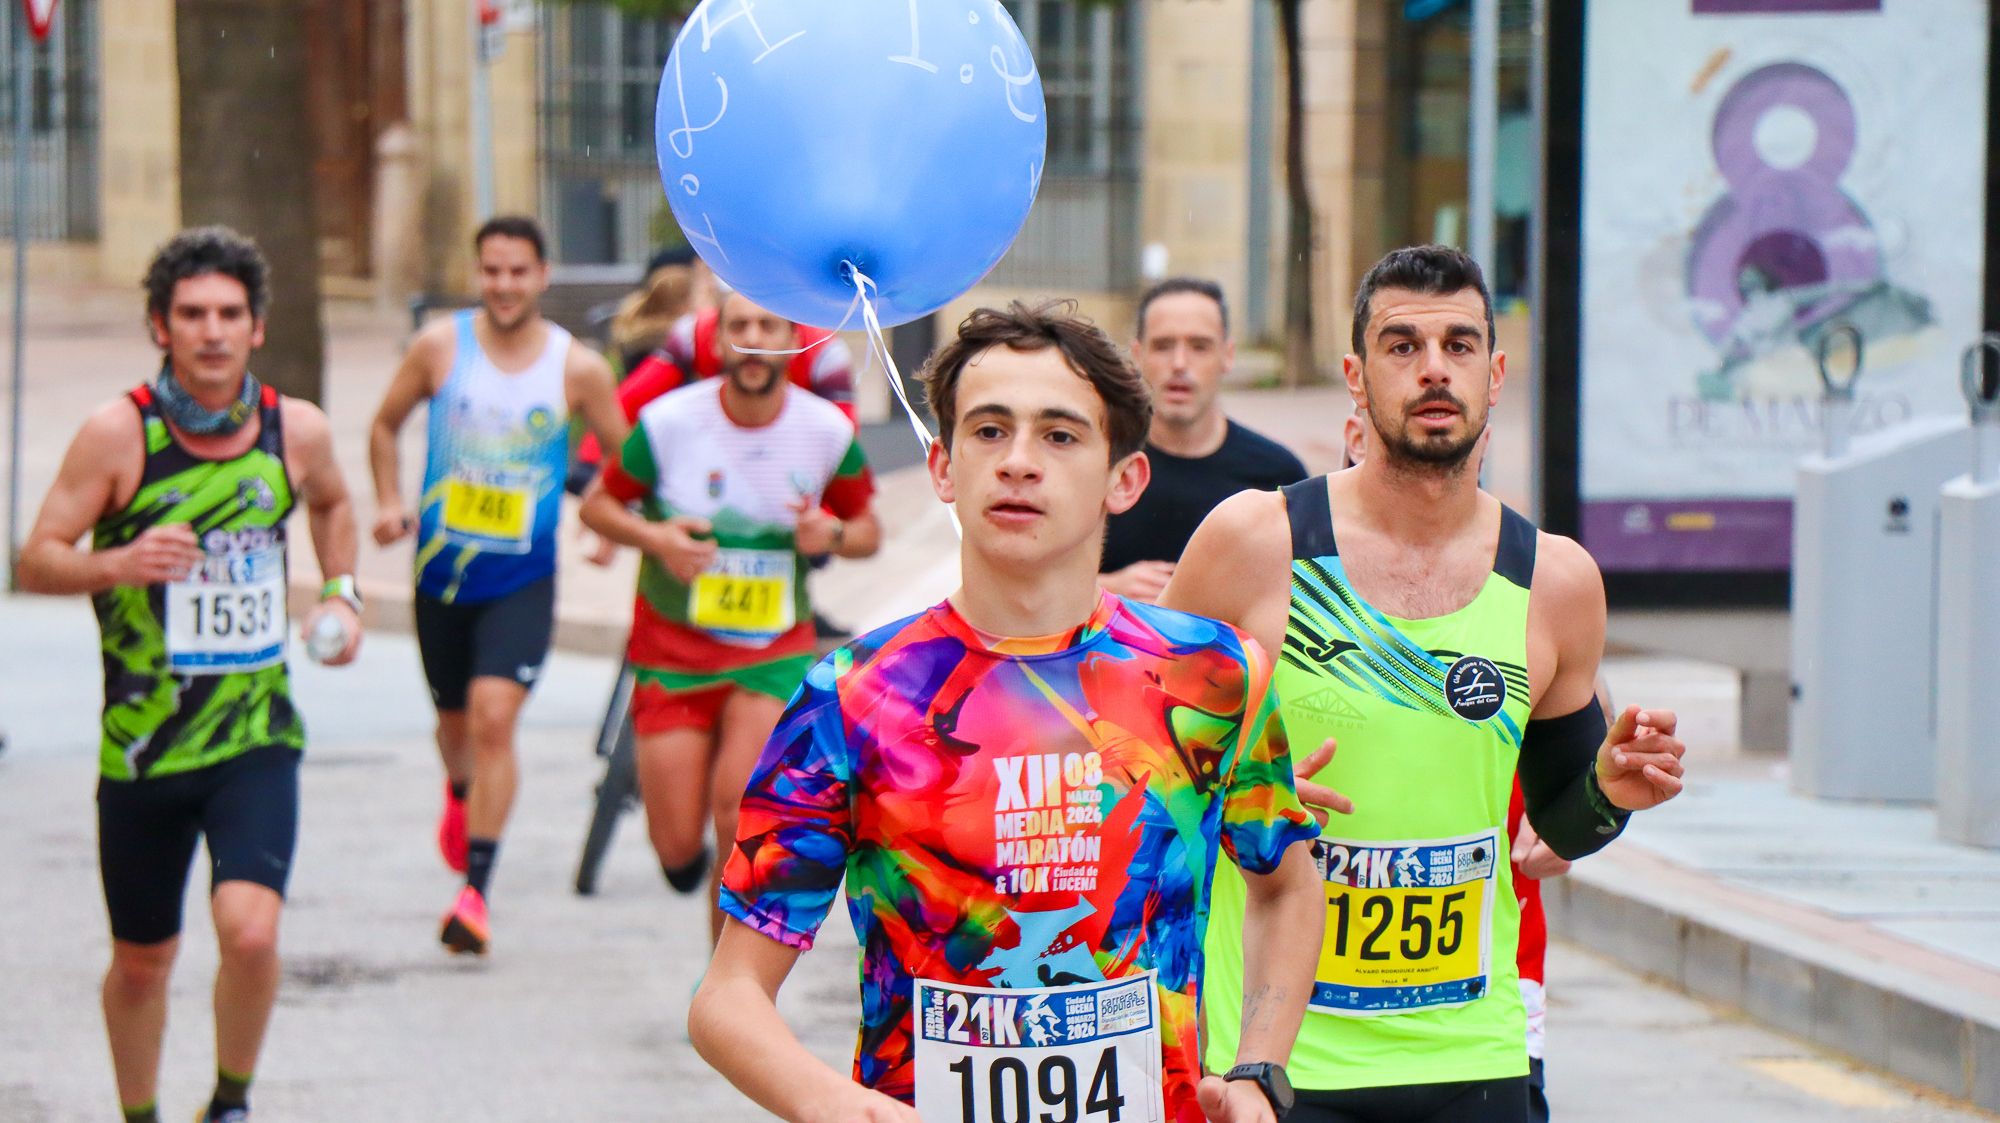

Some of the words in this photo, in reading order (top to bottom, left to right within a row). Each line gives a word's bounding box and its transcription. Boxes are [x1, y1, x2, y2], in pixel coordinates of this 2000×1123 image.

[1686, 61, 1882, 350] 8
[992, 753, 1062, 812] XII
[1064, 752, 1103, 787] 08
[1066, 789, 1103, 803] MARZO
[994, 809, 1066, 840] MEDIA
[1066, 806, 1103, 824] 2026
[996, 830, 1102, 868] MARATÓN
[994, 875, 1007, 894] &
[1009, 866, 1051, 894] 10K
[1053, 867, 1085, 877] Ciudad
[1087, 866, 1098, 877] de
[1330, 845, 1393, 888] 21K
[1429, 872, 1453, 886] 2026
[1053, 877, 1097, 891] LUCENA
[1328, 890, 1466, 961] 1255
[1065, 1003, 1095, 1015] LUCENA
[1101, 990, 1138, 1007] carreras
[1102, 996, 1146, 1018] populares
[946, 993, 1021, 1045] 21K
[1067, 1022, 1096, 1040] 2026
[950, 1045, 1125, 1123] 1094
